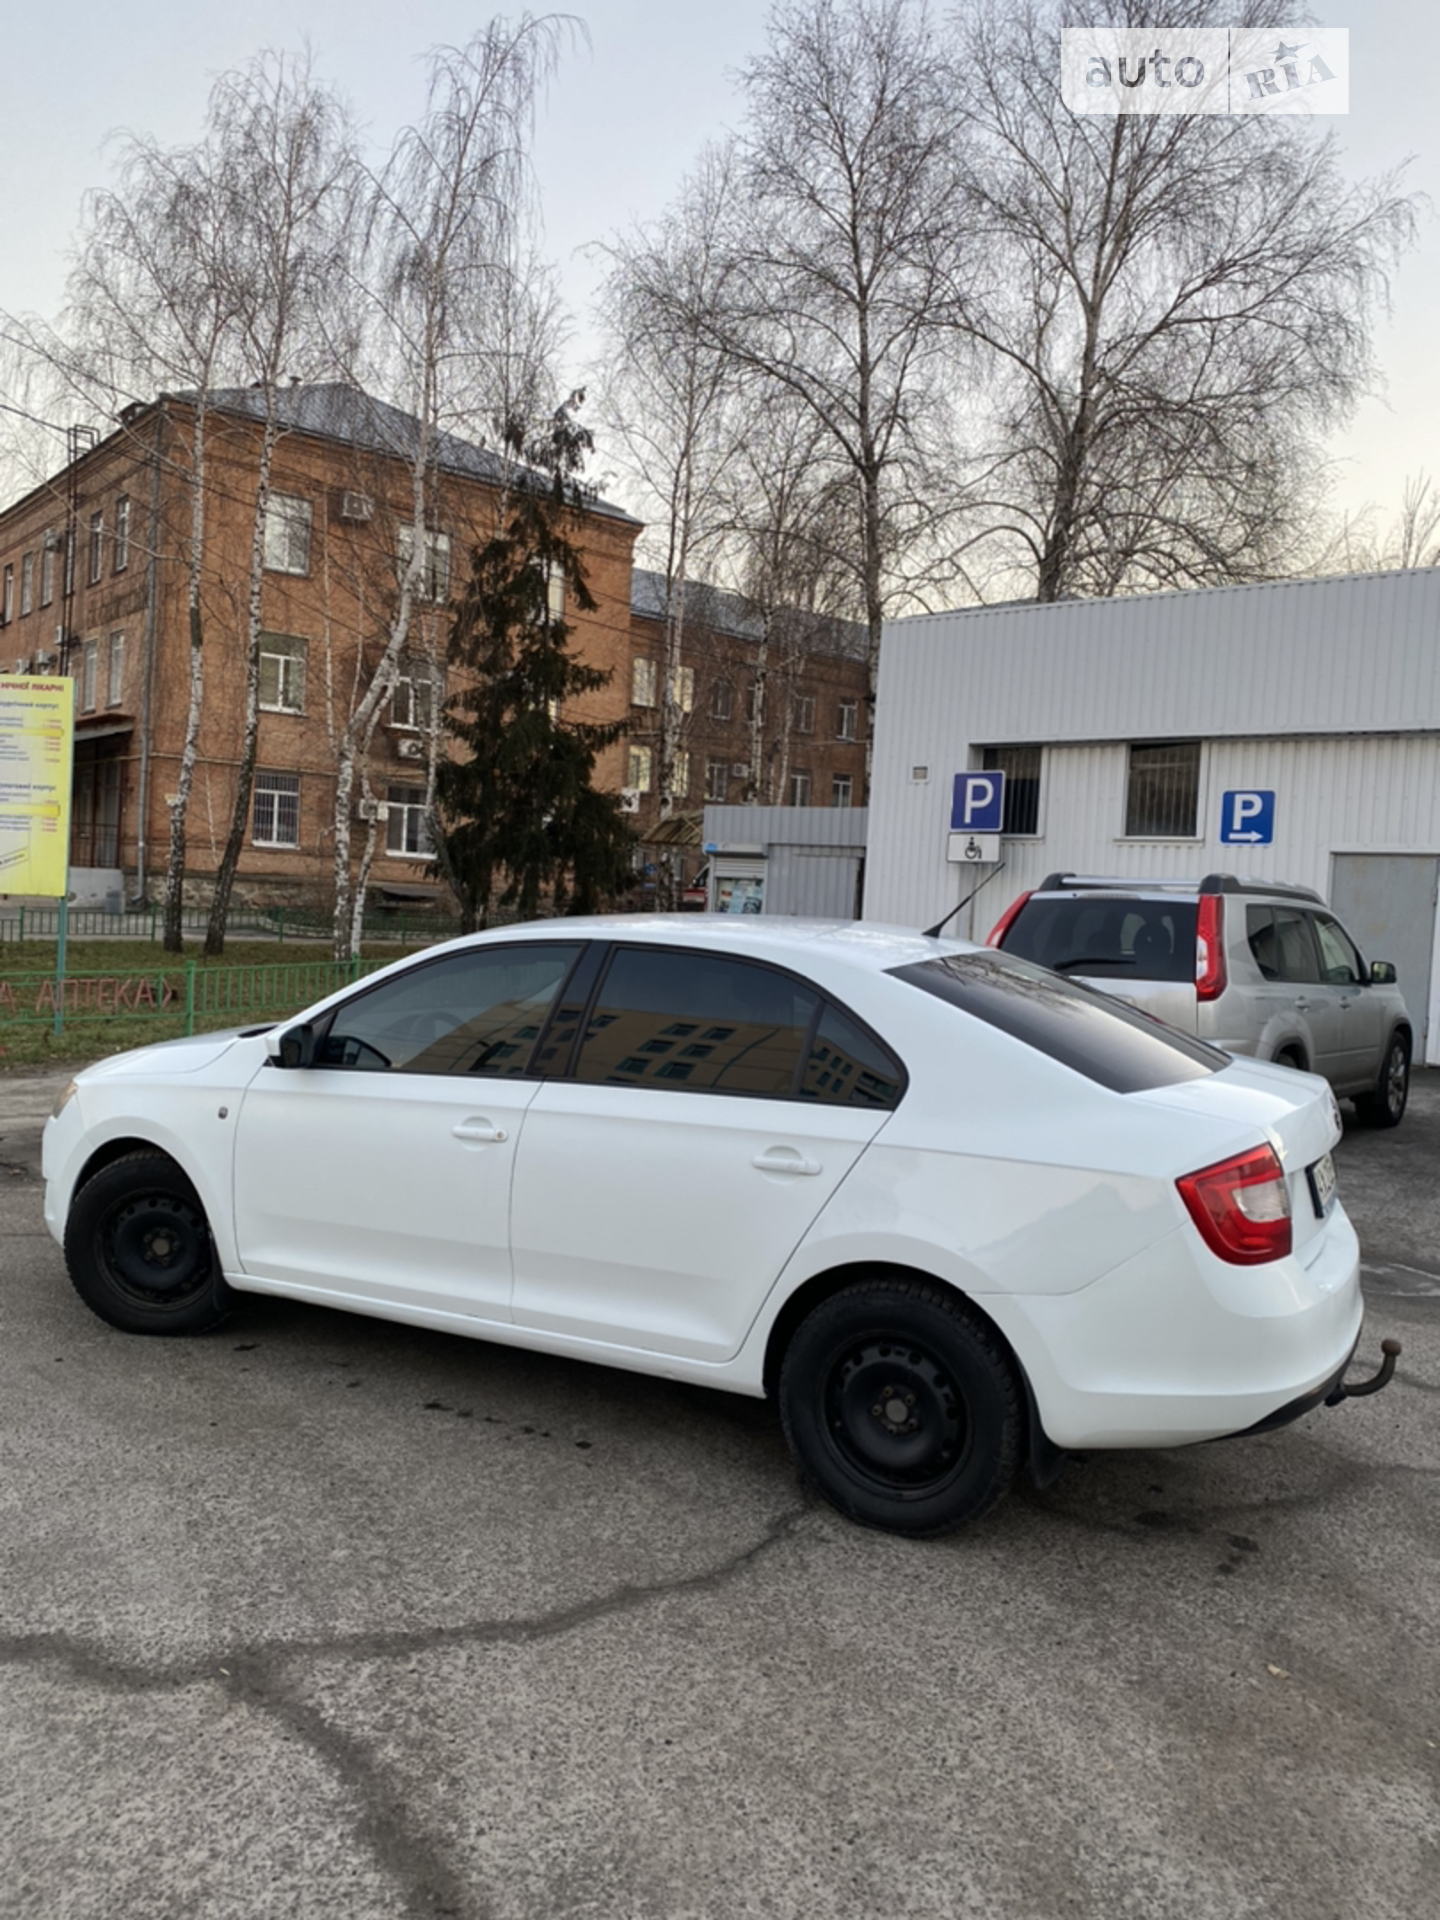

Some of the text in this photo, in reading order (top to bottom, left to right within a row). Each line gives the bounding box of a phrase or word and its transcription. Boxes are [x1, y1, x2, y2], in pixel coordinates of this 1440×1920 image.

[963, 778, 995, 824] P
[1232, 793, 1264, 831] P
[35, 976, 155, 1014] АПТЕКА
